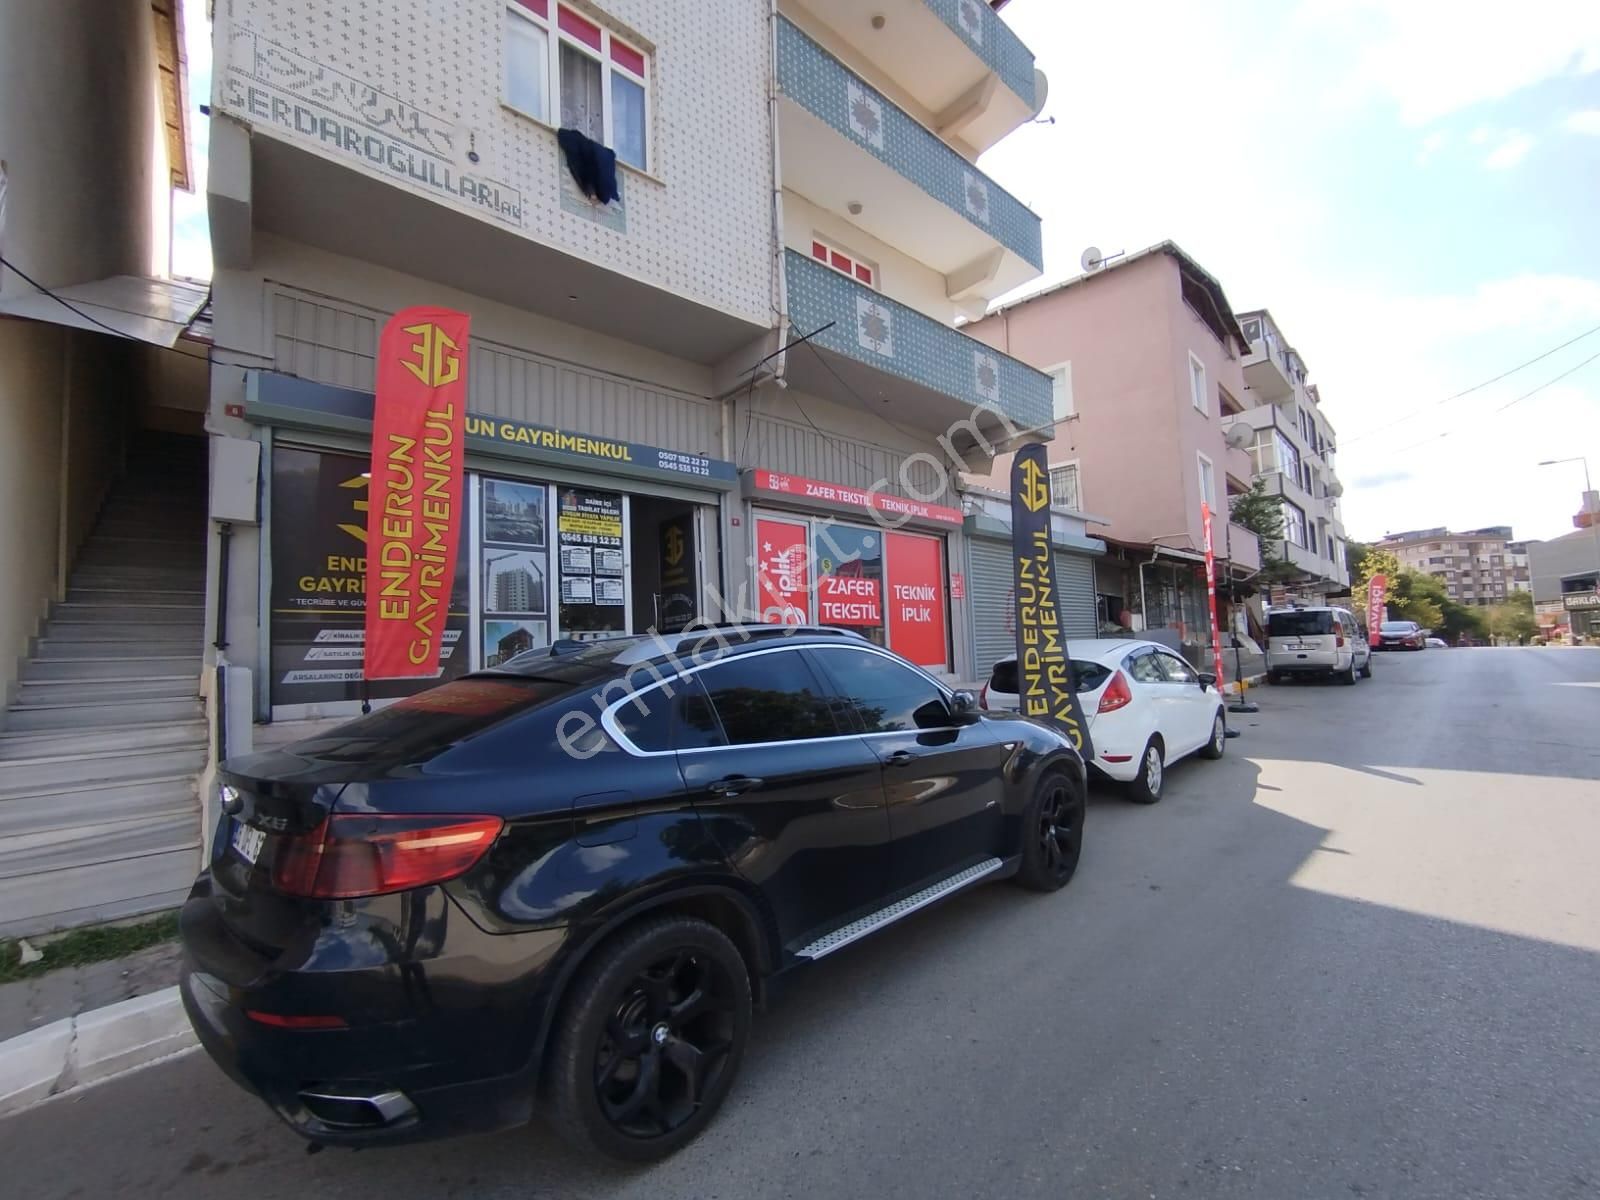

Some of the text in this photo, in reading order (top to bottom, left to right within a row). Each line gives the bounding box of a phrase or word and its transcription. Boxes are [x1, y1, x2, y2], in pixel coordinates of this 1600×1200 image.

[499, 424, 632, 461] GAYRİMENKUL
[806, 483, 836, 500] ZAFER
[380, 434, 417, 620] ENDERUN
[408, 403, 454, 665] GAYRİMENKUL
[599, 537, 610, 545] 12
[299, 575, 366, 594] GAYRİ
[826, 578, 875, 597] ZAFER
[894, 583, 937, 601] TEKNİK
[337, 599, 349, 607] VE
[822, 601, 881, 620] TEKSTİL
[902, 603, 932, 623] İPLİK
[1019, 557, 1050, 716] ENDERUN
